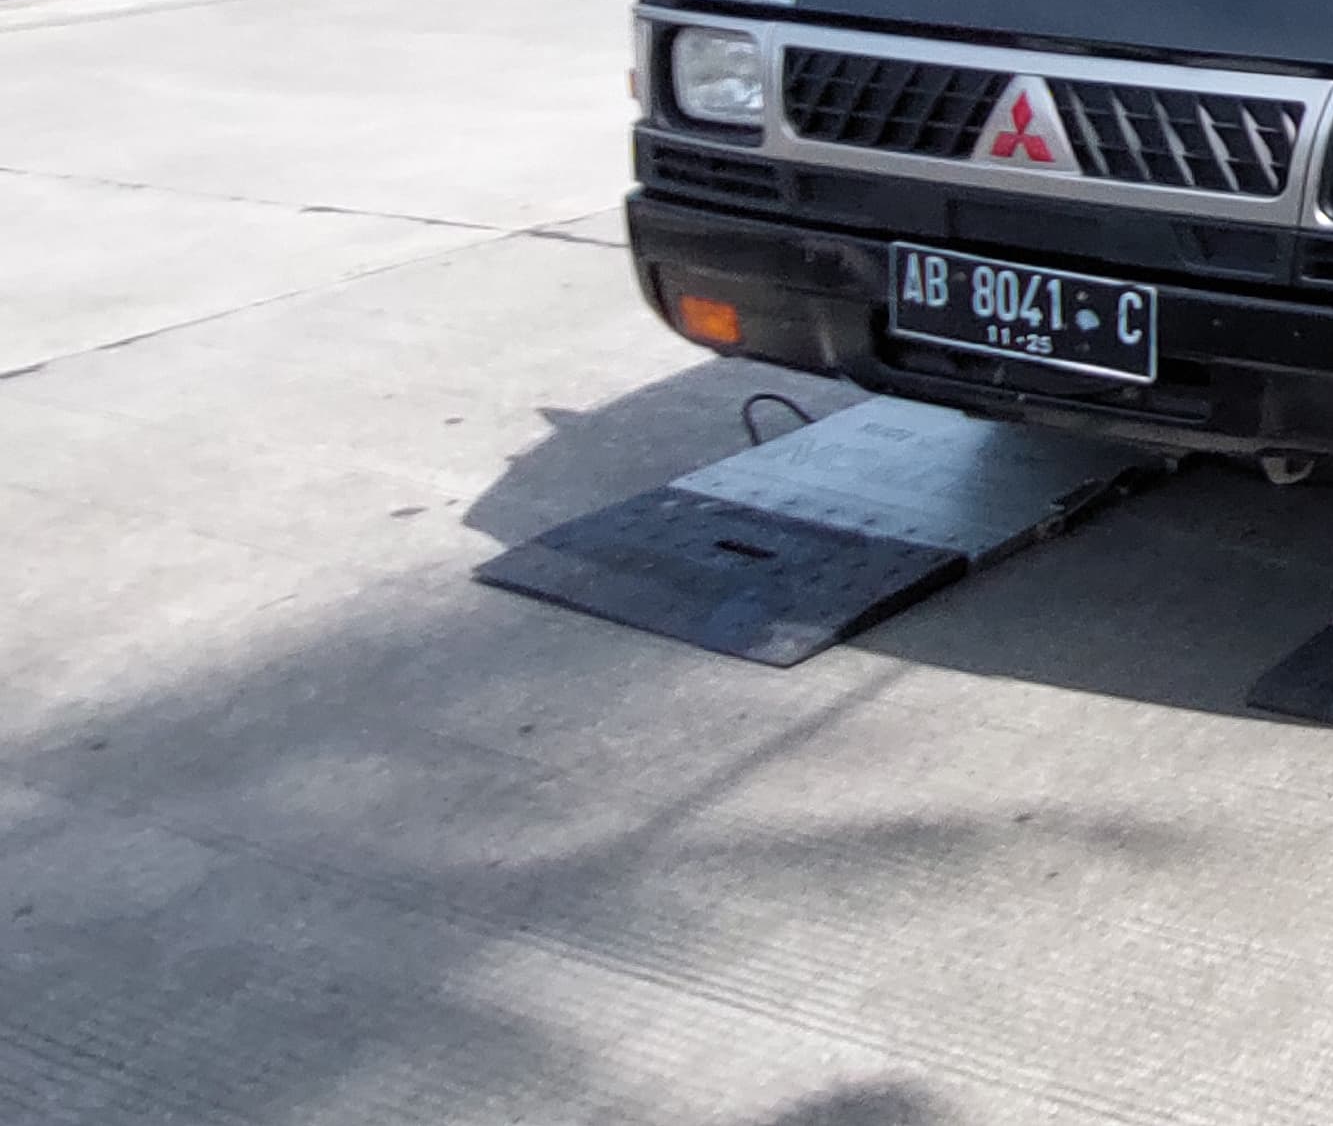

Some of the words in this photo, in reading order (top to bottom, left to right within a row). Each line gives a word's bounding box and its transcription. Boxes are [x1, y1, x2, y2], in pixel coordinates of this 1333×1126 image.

[903, 252, 949, 308] AB
[972, 265, 1065, 332] 8041
[1117, 291, 1143, 345] C
